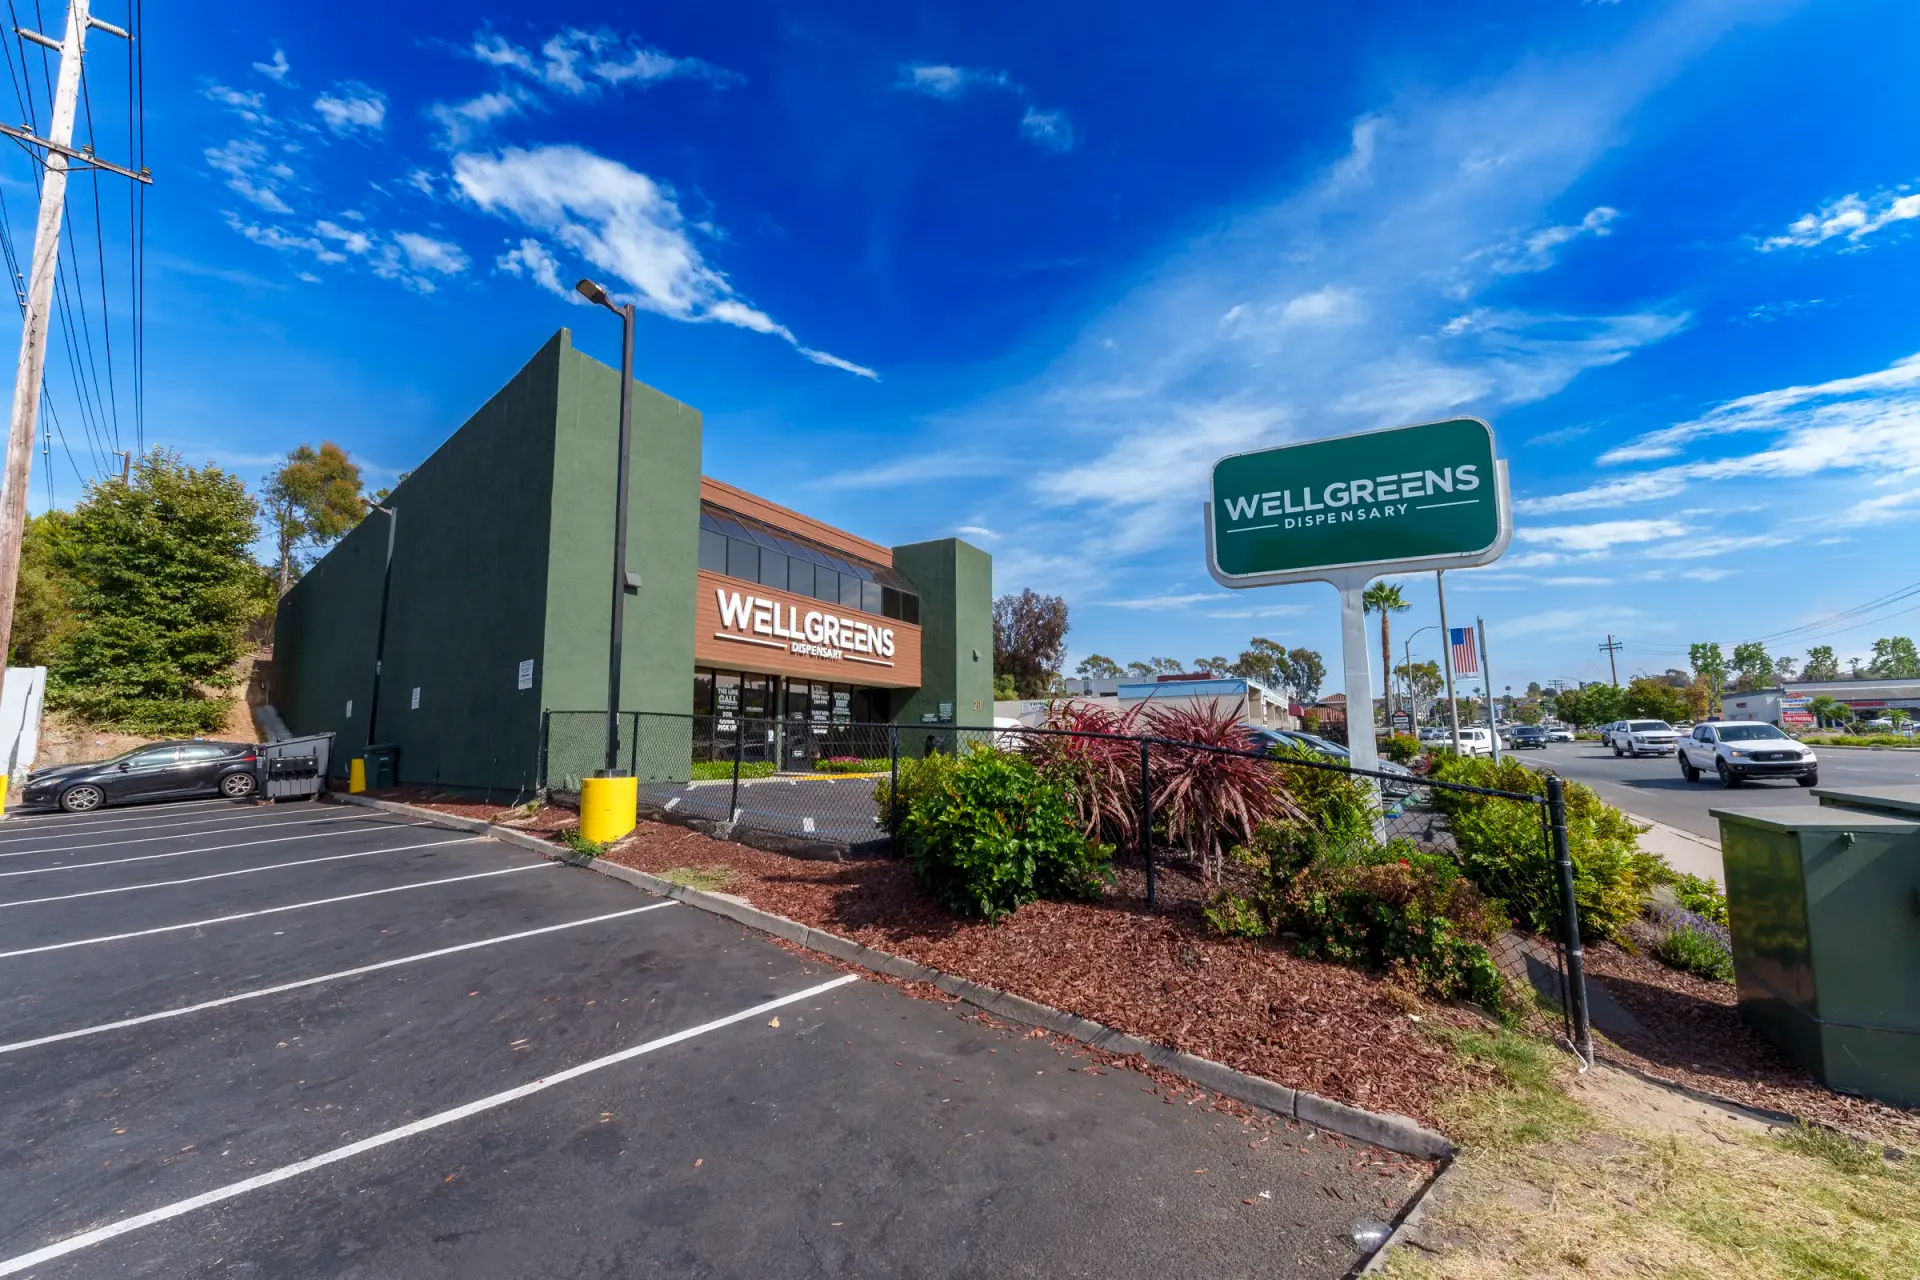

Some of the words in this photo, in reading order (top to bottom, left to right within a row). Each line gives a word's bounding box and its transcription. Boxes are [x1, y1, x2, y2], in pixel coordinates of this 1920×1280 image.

[1223, 464, 1480, 521] WELLGREENS
[1284, 503, 1408, 529] DISPENSARY
[716, 588, 895, 657] WELLGREENS
[790, 642, 843, 659] DISPENSARY
[718, 695, 738, 704] CALL
[833, 692, 851, 701] VOTED
[717, 724, 729, 732] PICK
[730, 724, 737, 732] UP
